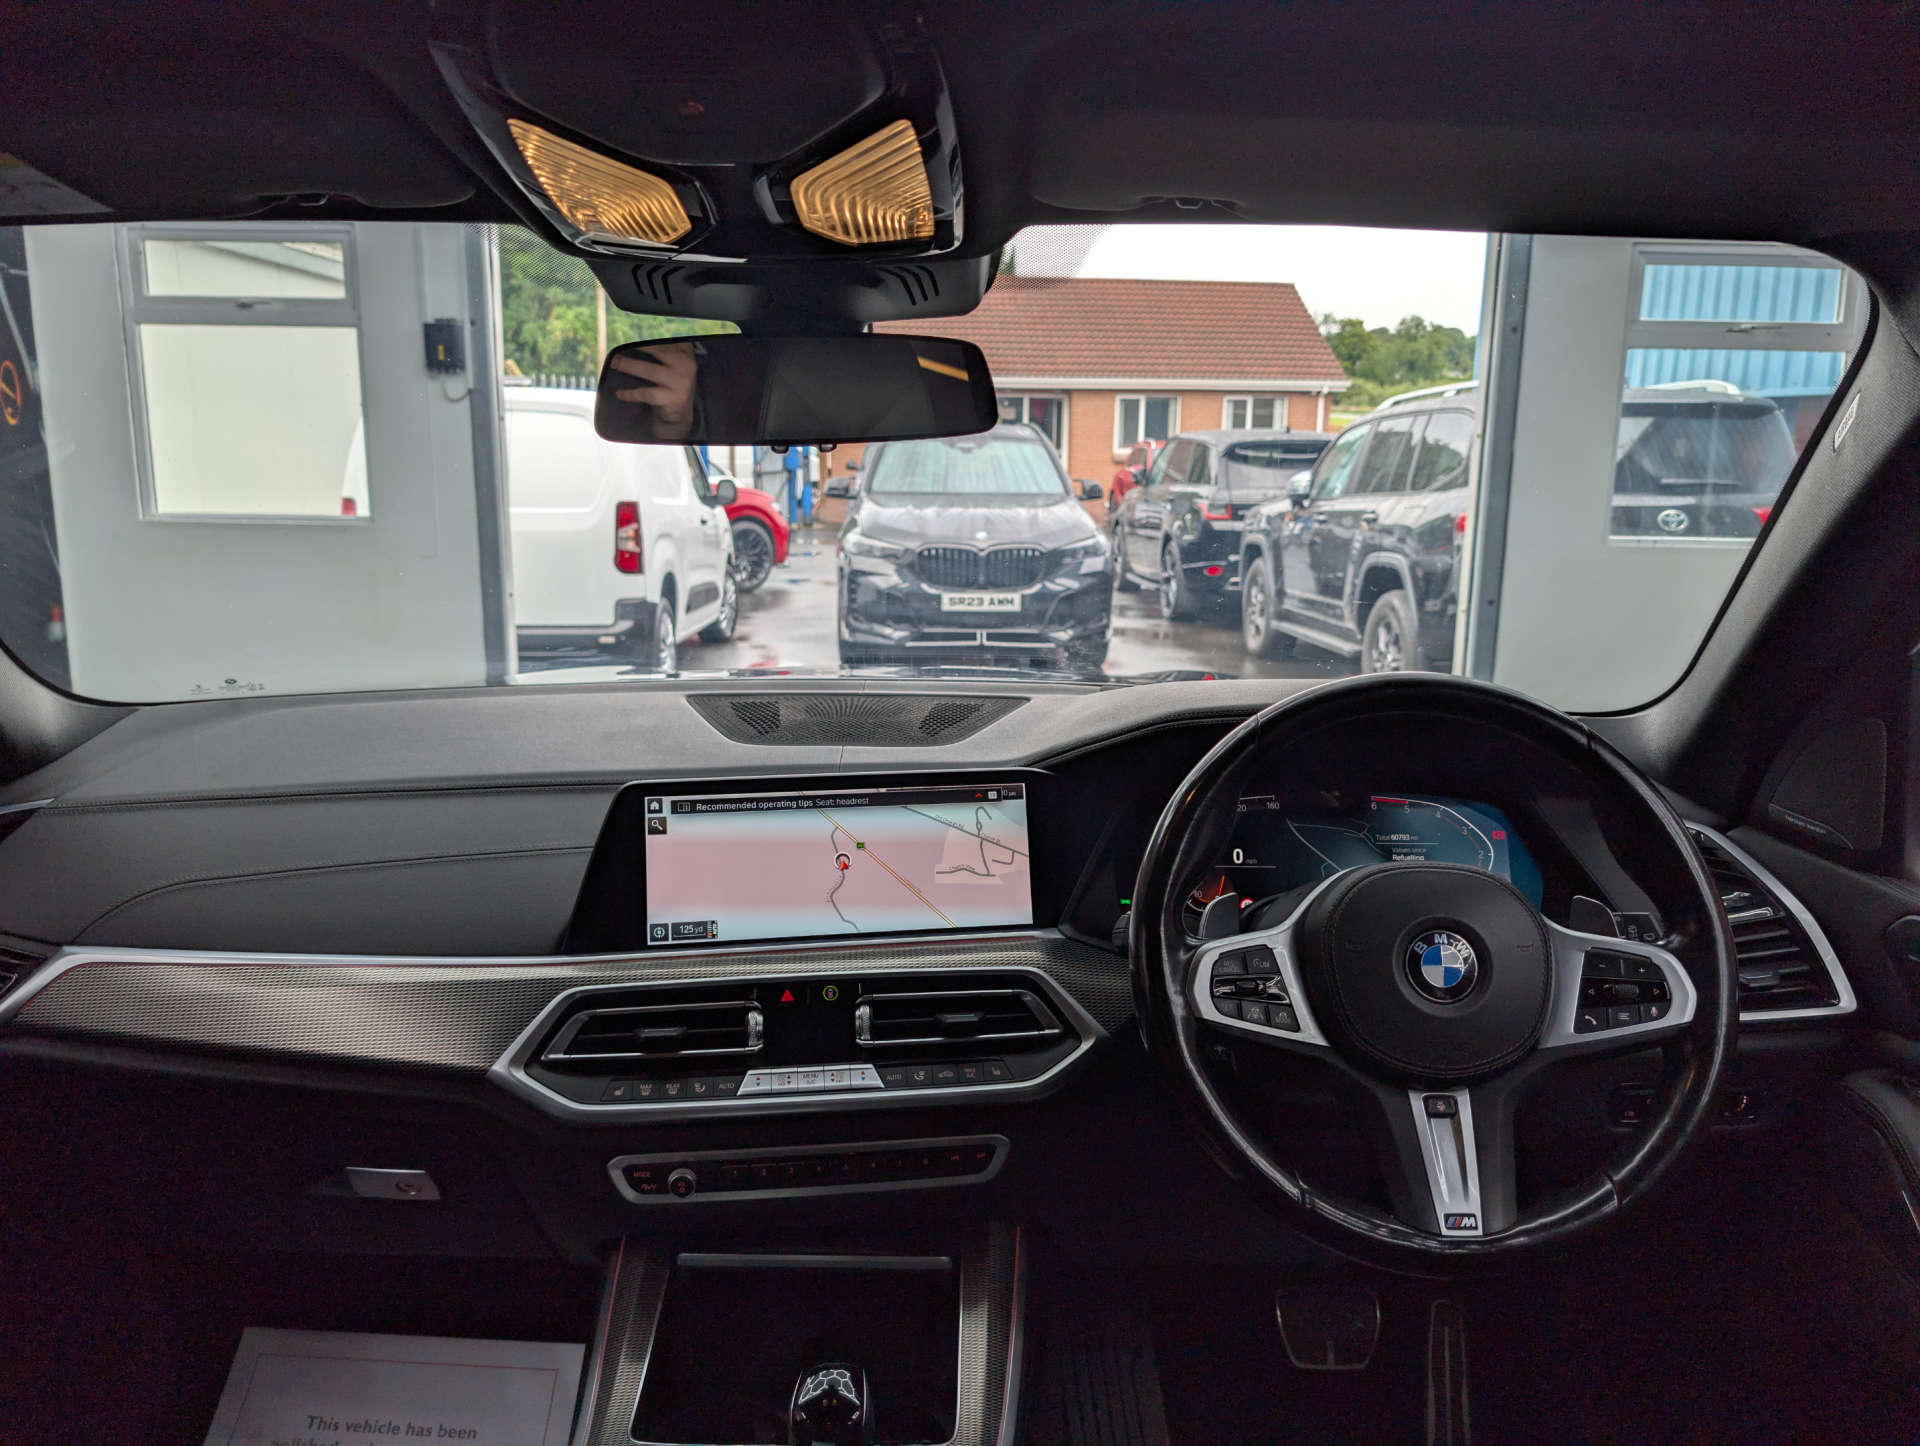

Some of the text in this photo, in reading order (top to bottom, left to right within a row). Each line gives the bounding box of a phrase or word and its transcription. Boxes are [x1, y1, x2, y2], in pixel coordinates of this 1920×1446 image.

[696, 801, 757, 812] Recommended
[758, 801, 797, 811] operating
[798, 800, 814, 809] tips
[836, 797, 870, 806] headrest
[1266, 801, 1280, 810] 160
[1371, 803, 1377, 811] 6
[1461, 827, 1468, 835] 3
[1232, 848, 1244, 864] 0
[679, 924, 694, 934] 125
[1413, 933, 1471, 958] BMW
[306, 1415, 478, 1440] This vehicle has been
